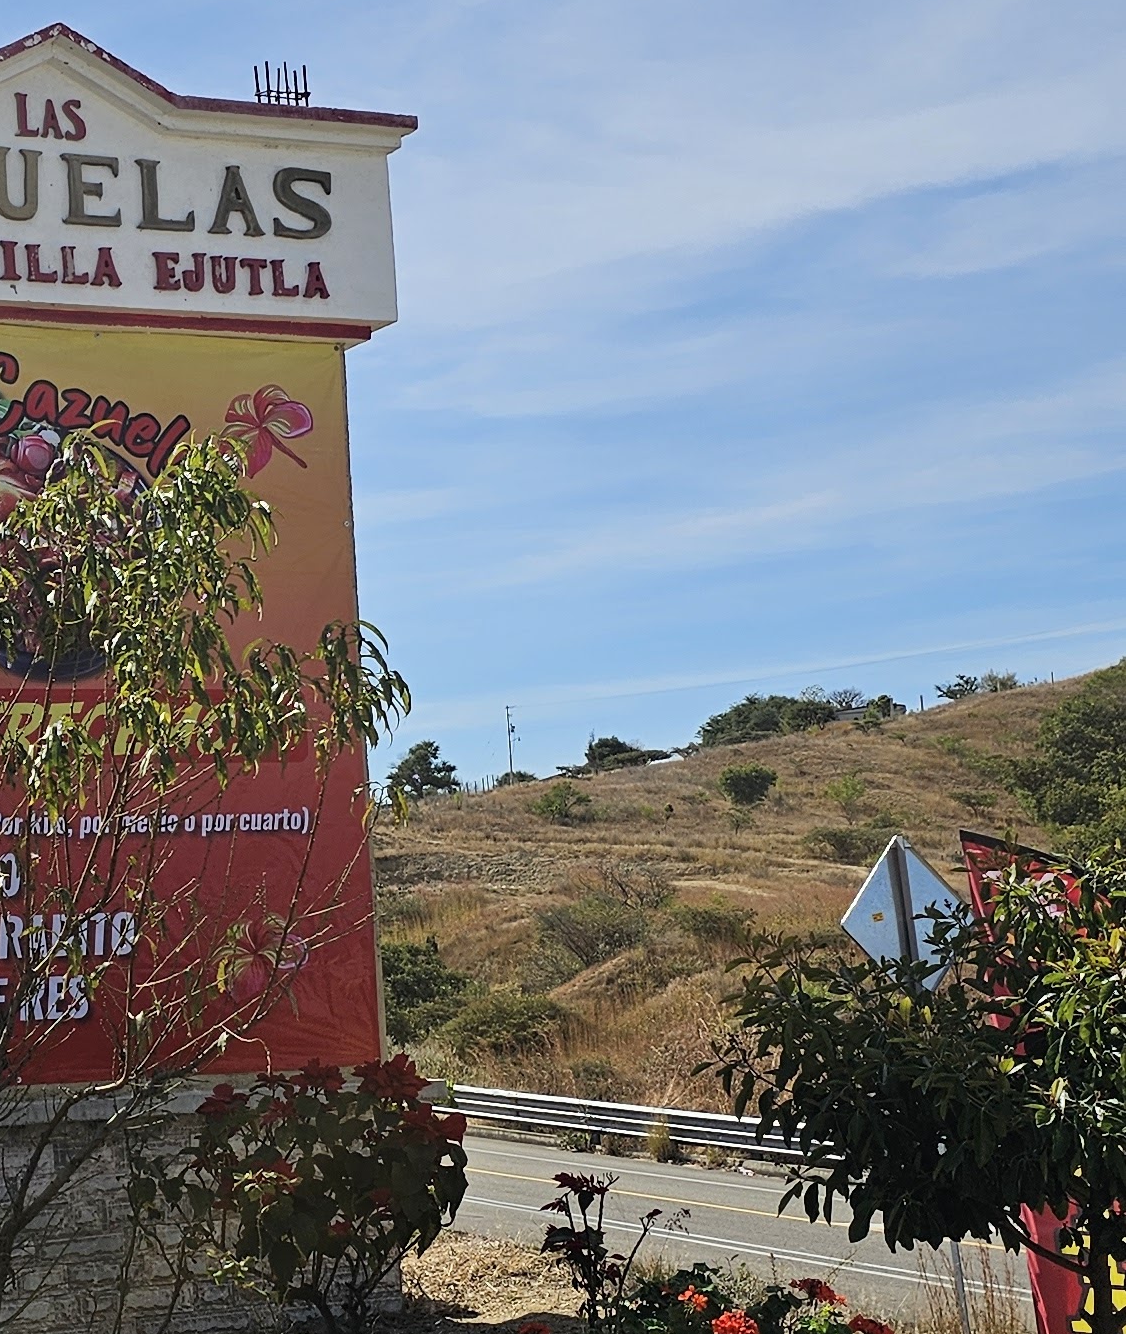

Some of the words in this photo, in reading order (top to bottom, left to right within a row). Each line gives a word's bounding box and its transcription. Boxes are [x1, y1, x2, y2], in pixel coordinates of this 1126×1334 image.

[14, 92, 87, 141] LAS
[151, 251, 330, 299] EJUTLA
[30, 810, 72, 838] kio,
[185, 812, 196, 832] o
[201, 812, 233, 837] por
[239, 806, 310, 835] cuarto)
[19, 975, 90, 1022] RES
